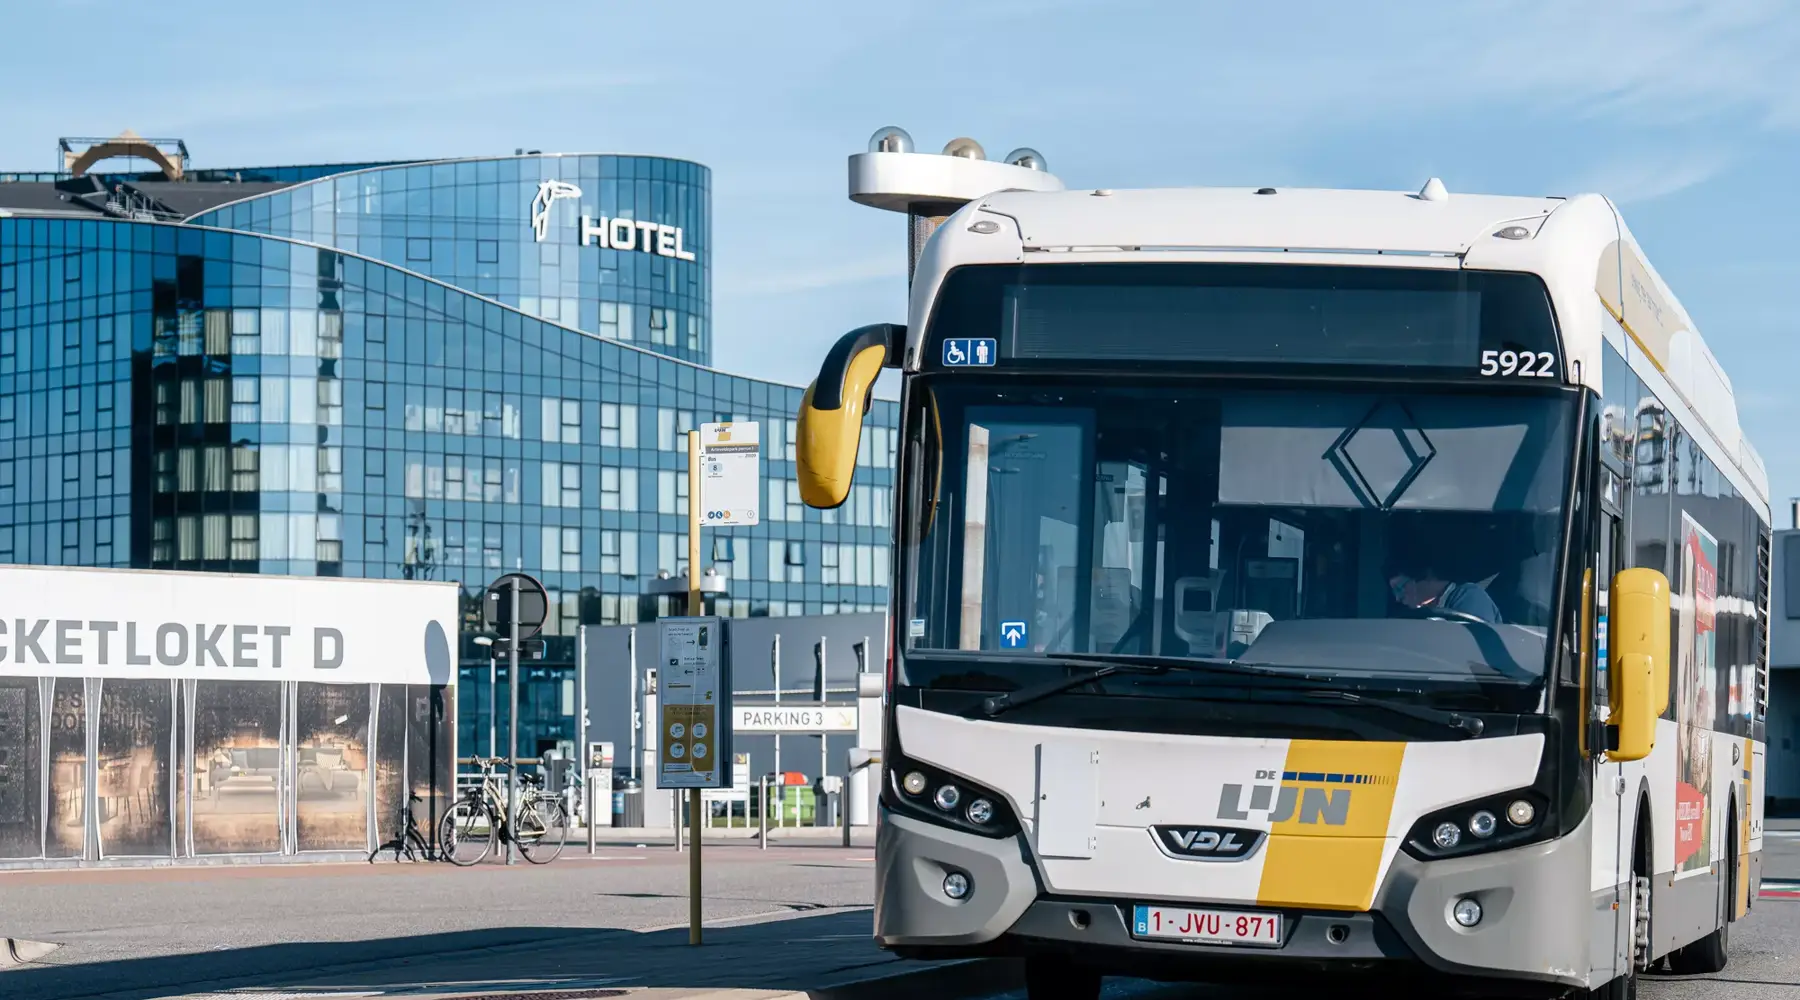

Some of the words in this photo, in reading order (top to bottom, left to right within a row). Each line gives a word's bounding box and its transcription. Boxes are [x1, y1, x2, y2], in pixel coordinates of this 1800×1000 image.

[580, 214, 696, 261] HOTEL
[1480, 350, 1555, 377] 5922
[0, 618, 291, 669] KETLOKET
[313, 627, 344, 669] D
[743, 711, 811, 726] PARKING
[815, 711, 824, 726] 3
[1255, 770, 1276, 780] DE
[1216, 783, 1353, 826] LIJN
[1168, 830, 1243, 851] VDL
[1138, 921, 1147, 932] B
[1152, 911, 1275, 939] 1-JVU-871
